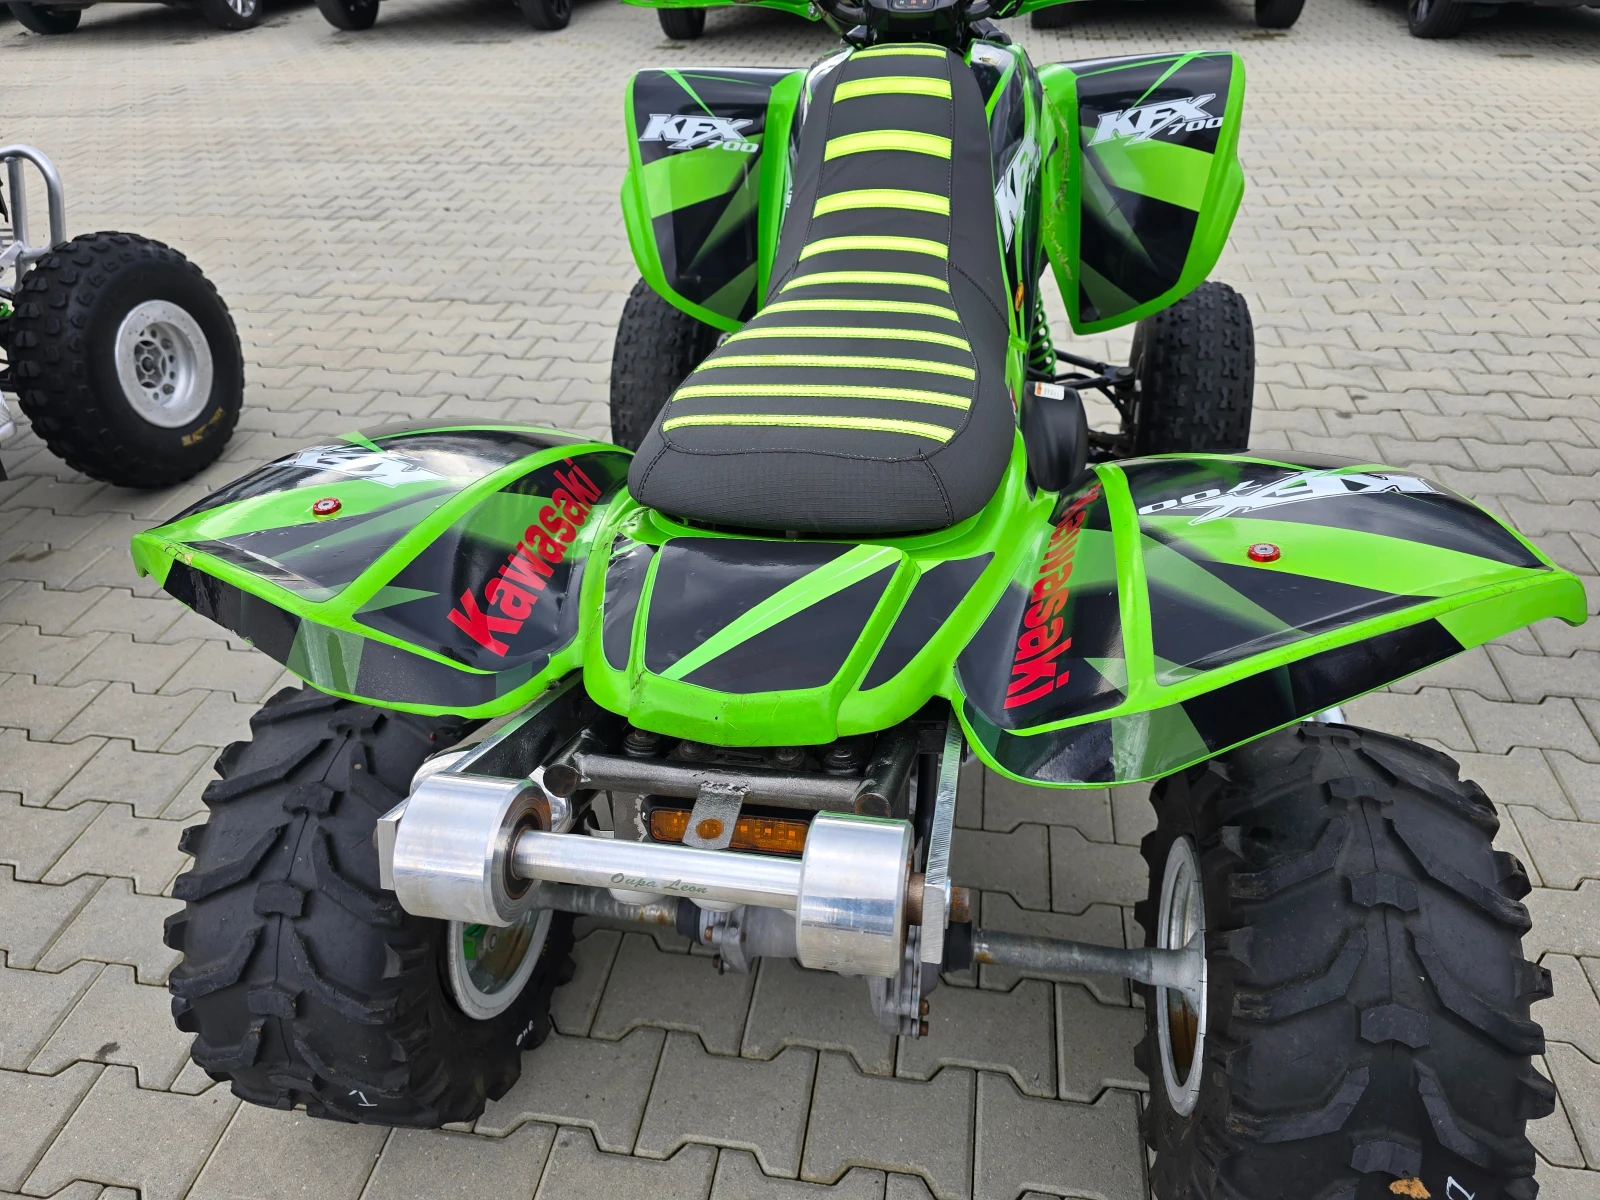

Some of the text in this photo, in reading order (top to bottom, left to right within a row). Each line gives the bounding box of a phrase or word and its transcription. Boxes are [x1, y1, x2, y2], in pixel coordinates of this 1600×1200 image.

[638, 113, 753, 150] KFX
[1087, 93, 1216, 146] KFX
[1168, 116, 1224, 135] 700
[707, 139, 759, 153] 700
[446, 457, 602, 658] Kawasaki
[1003, 483, 1103, 710] Kawasaki
[610, 872, 708, 895] Oupa Leon
